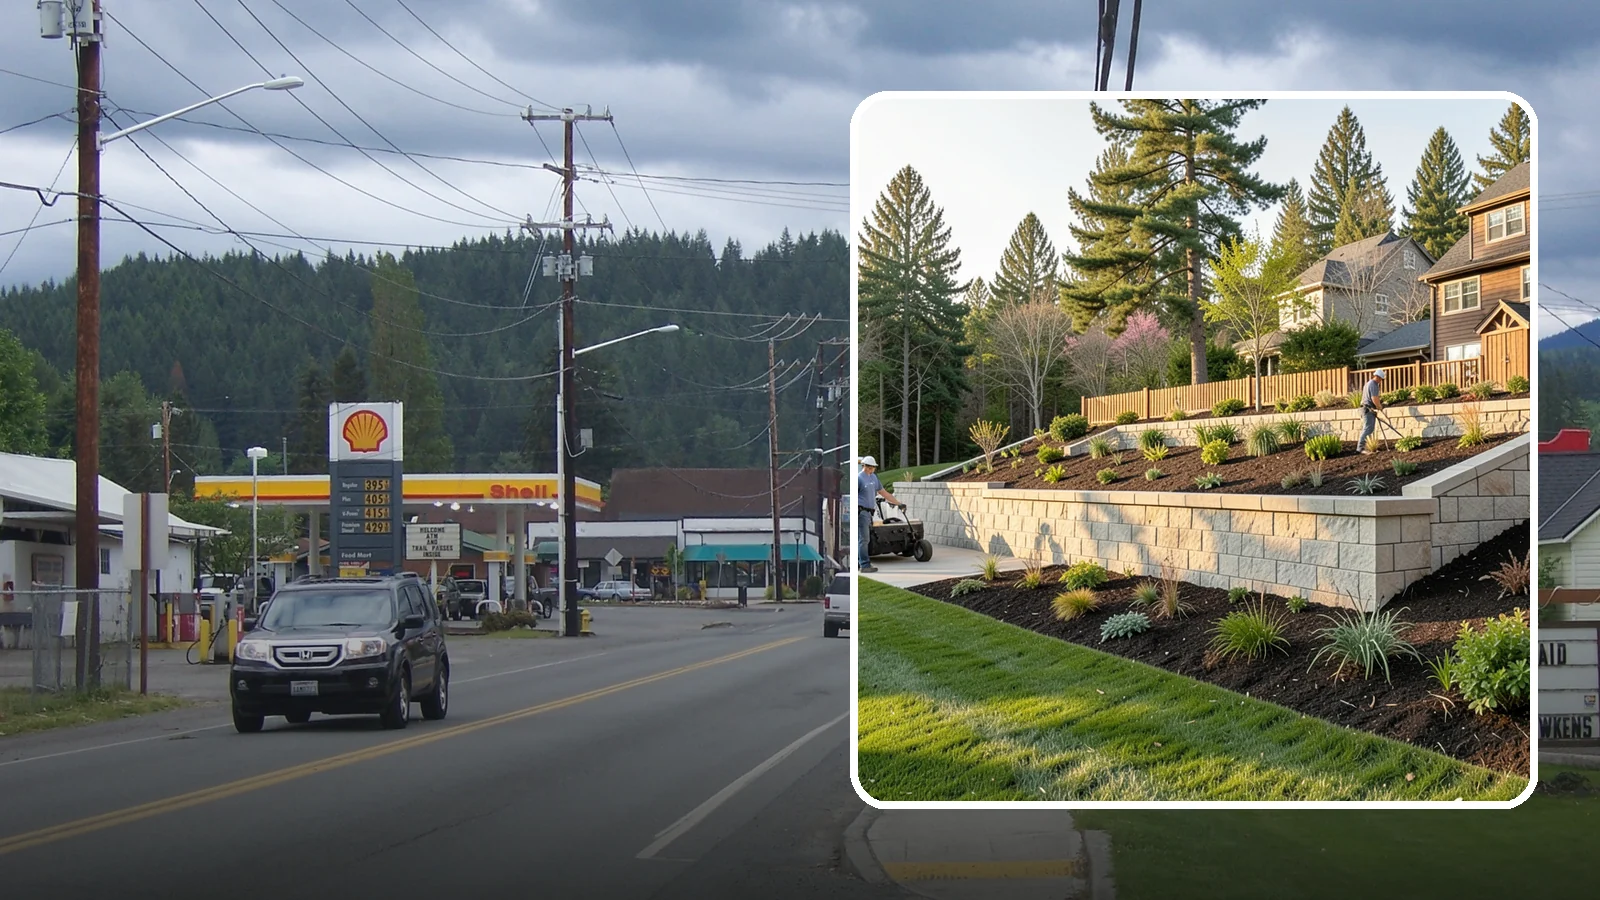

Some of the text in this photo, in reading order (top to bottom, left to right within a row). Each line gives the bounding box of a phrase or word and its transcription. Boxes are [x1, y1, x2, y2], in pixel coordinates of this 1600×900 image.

[366, 480, 383, 490] 395
[490, 484, 547, 499] Shell
[366, 494, 383, 504] 405
[366, 508, 383, 518] 415
[366, 522, 383, 533] 429
[1538, 643, 1566, 665] AID
